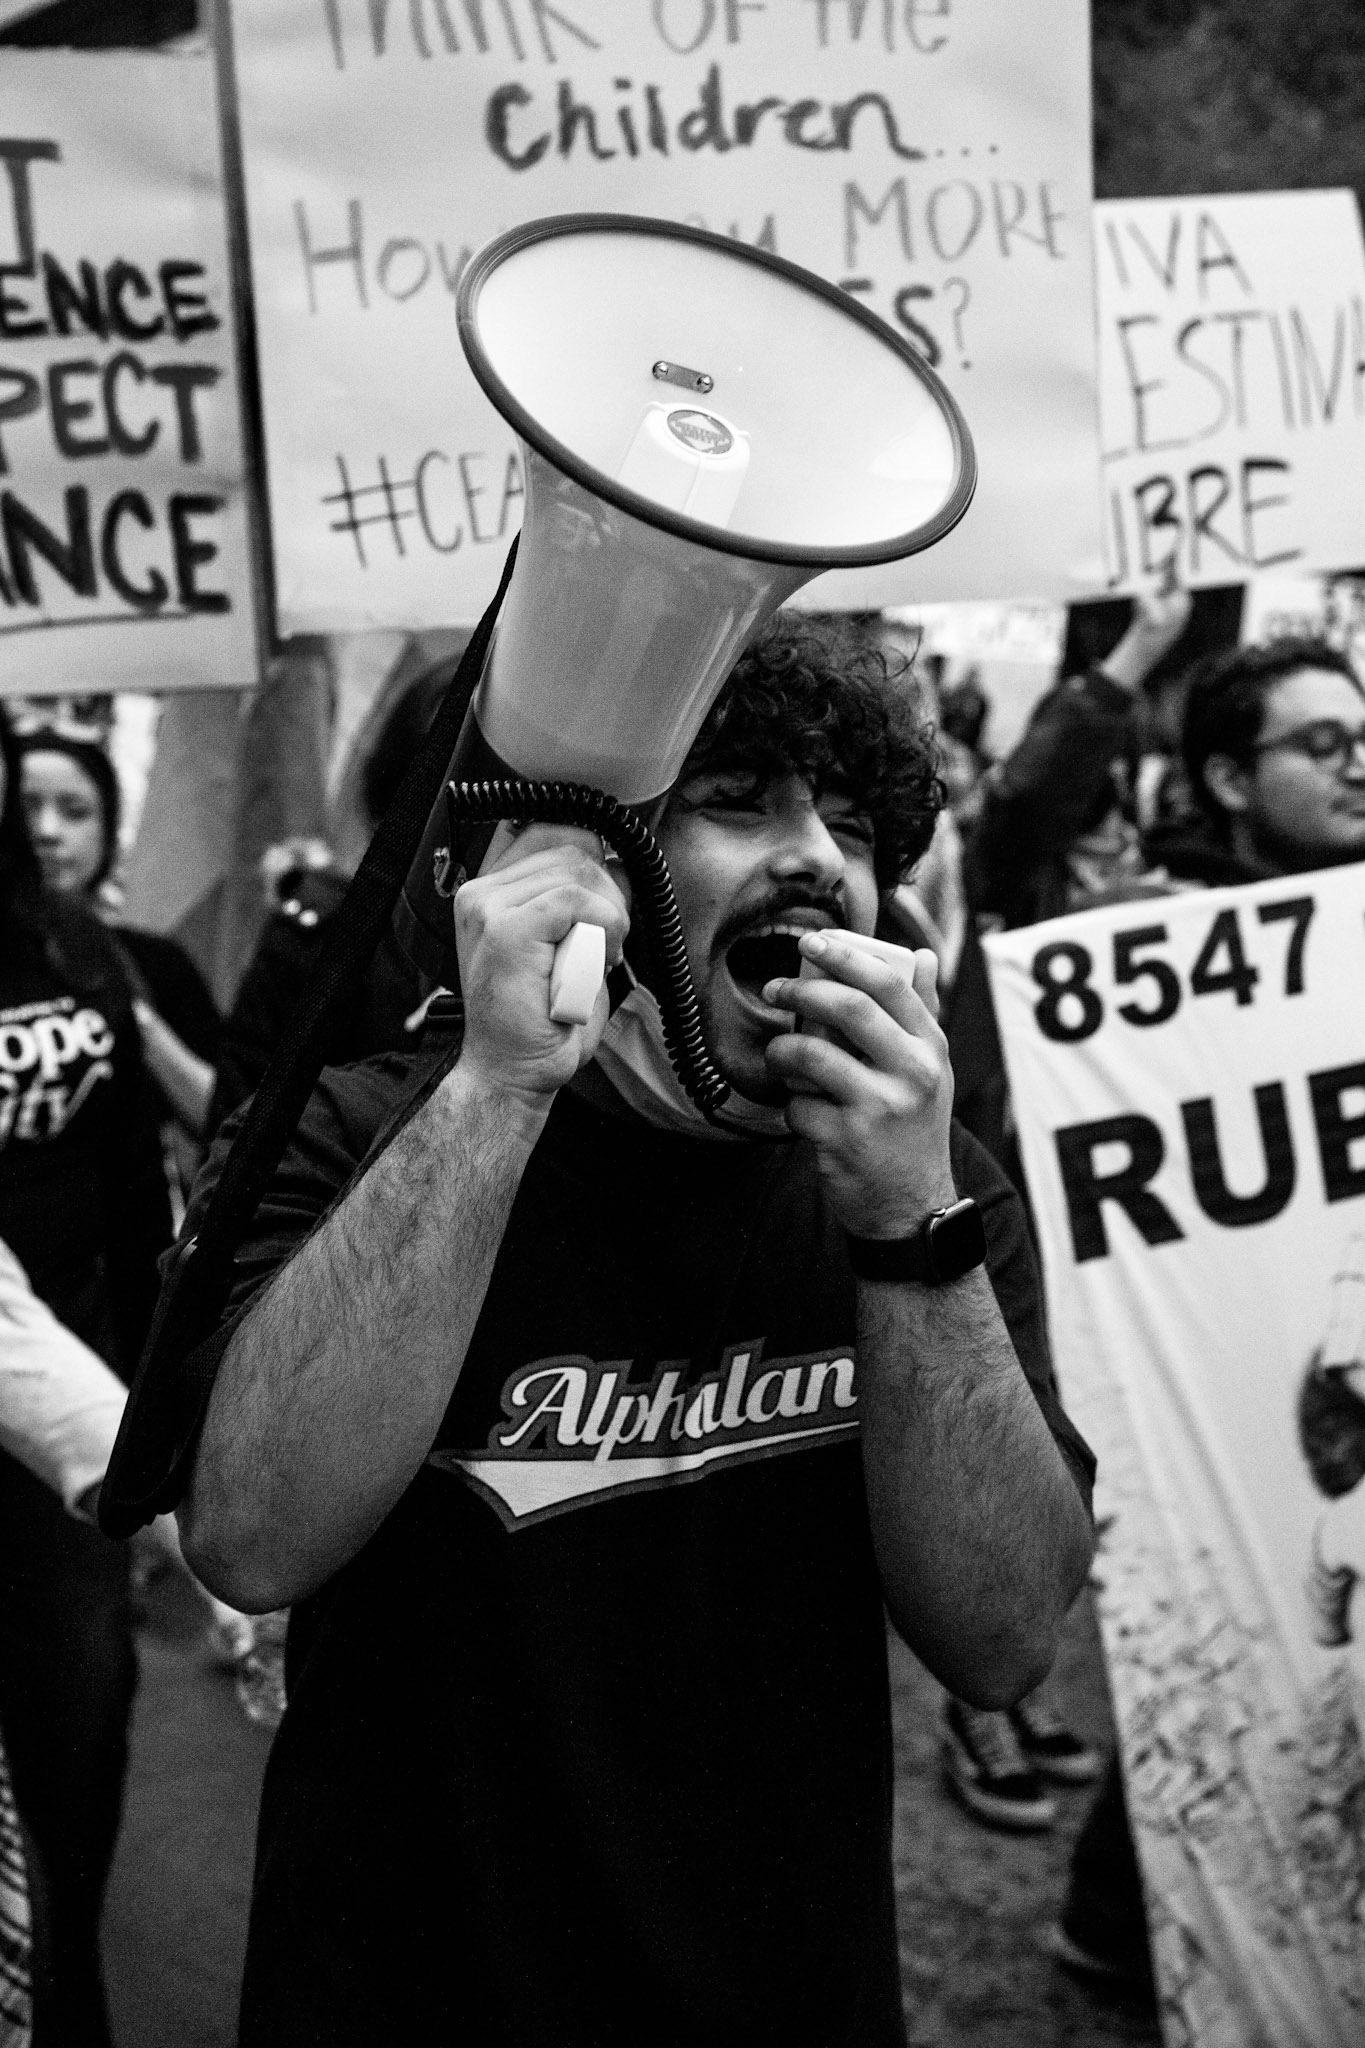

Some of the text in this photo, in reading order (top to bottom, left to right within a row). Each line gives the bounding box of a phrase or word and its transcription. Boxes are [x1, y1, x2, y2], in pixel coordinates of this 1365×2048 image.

[843, 176, 1068, 269] MORE
[0, 250, 221, 345] ENCE
[0, 484, 232, 615] NCE
[1031, 895, 1317, 1045] 8547
